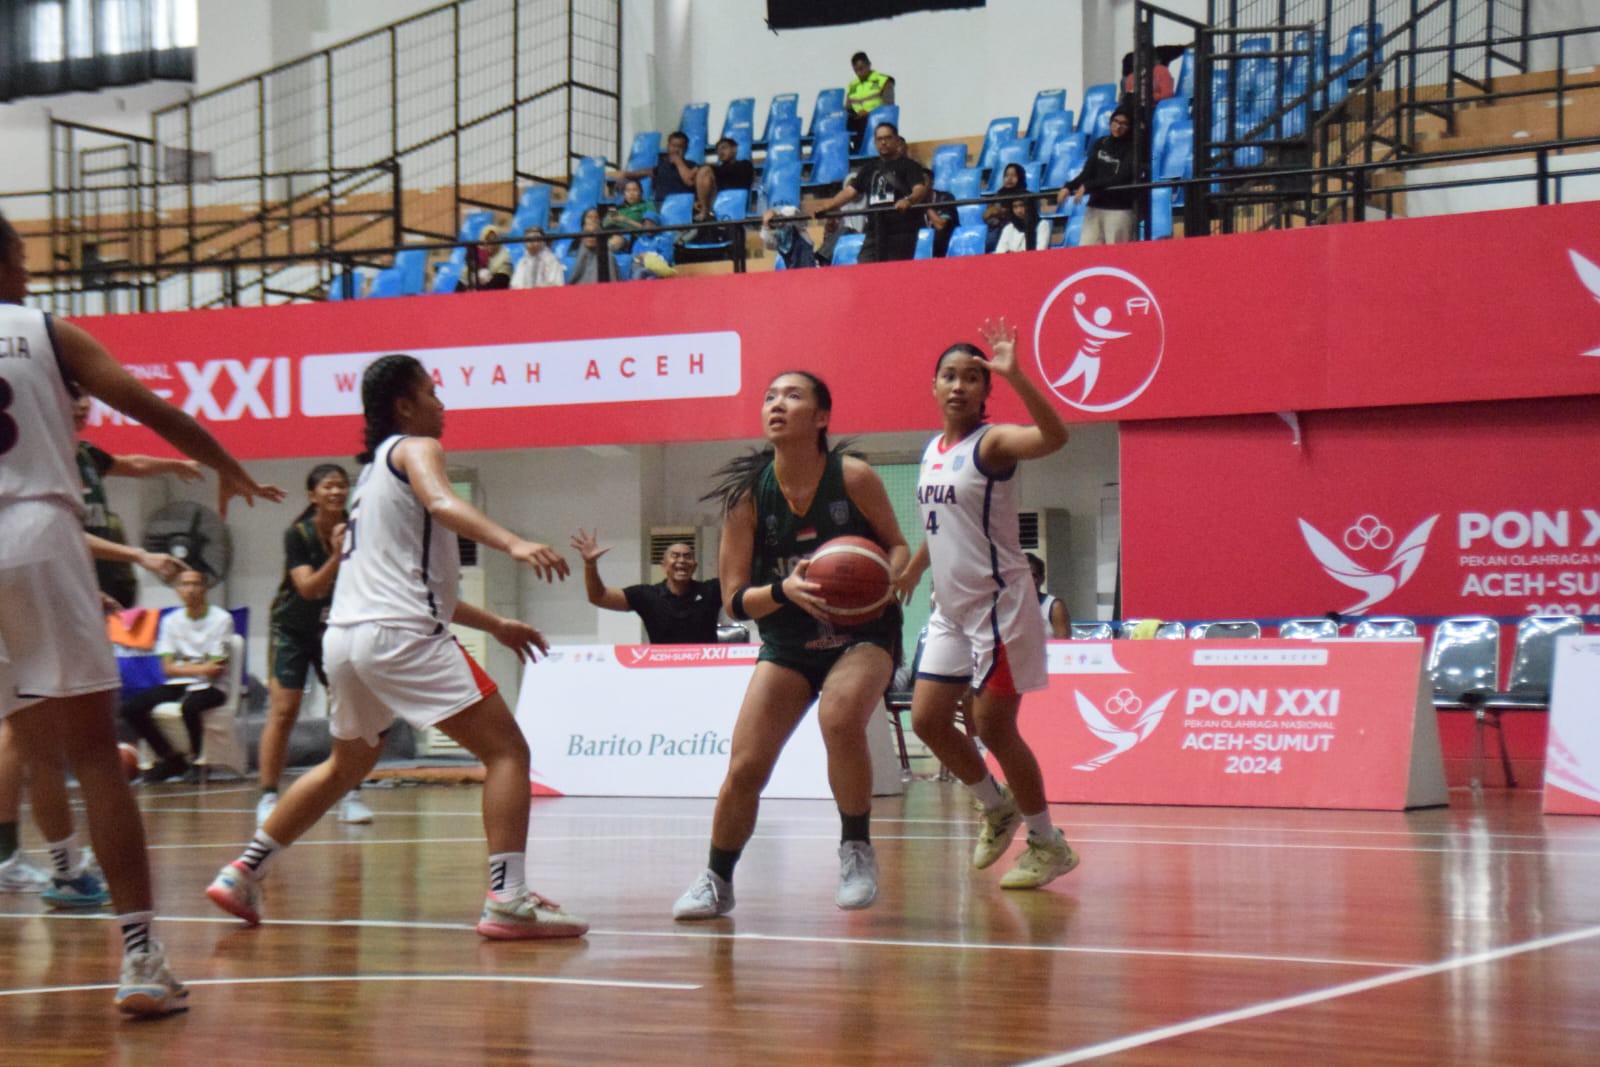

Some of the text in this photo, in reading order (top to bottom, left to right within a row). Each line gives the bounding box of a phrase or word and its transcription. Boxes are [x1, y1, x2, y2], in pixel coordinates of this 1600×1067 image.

[334, 353, 704, 392] WAYAH ACEH
[175, 356, 290, 421] XXI
[926, 511, 939, 535] 4
[1458, 510, 1569, 550] PON
[1459, 555, 1508, 567] PEKAN
[701, 646, 727, 660] XXI
[1185, 687, 1341, 717] PON XXI
[1184, 719, 1336, 730] PEKAN OLAHRAGA NASIONAL
[567, 730, 730, 757] Barito Pacific
[1181, 732, 1335, 752] ACEH-SUMUT
[1224, 755, 1283, 775] 2024
